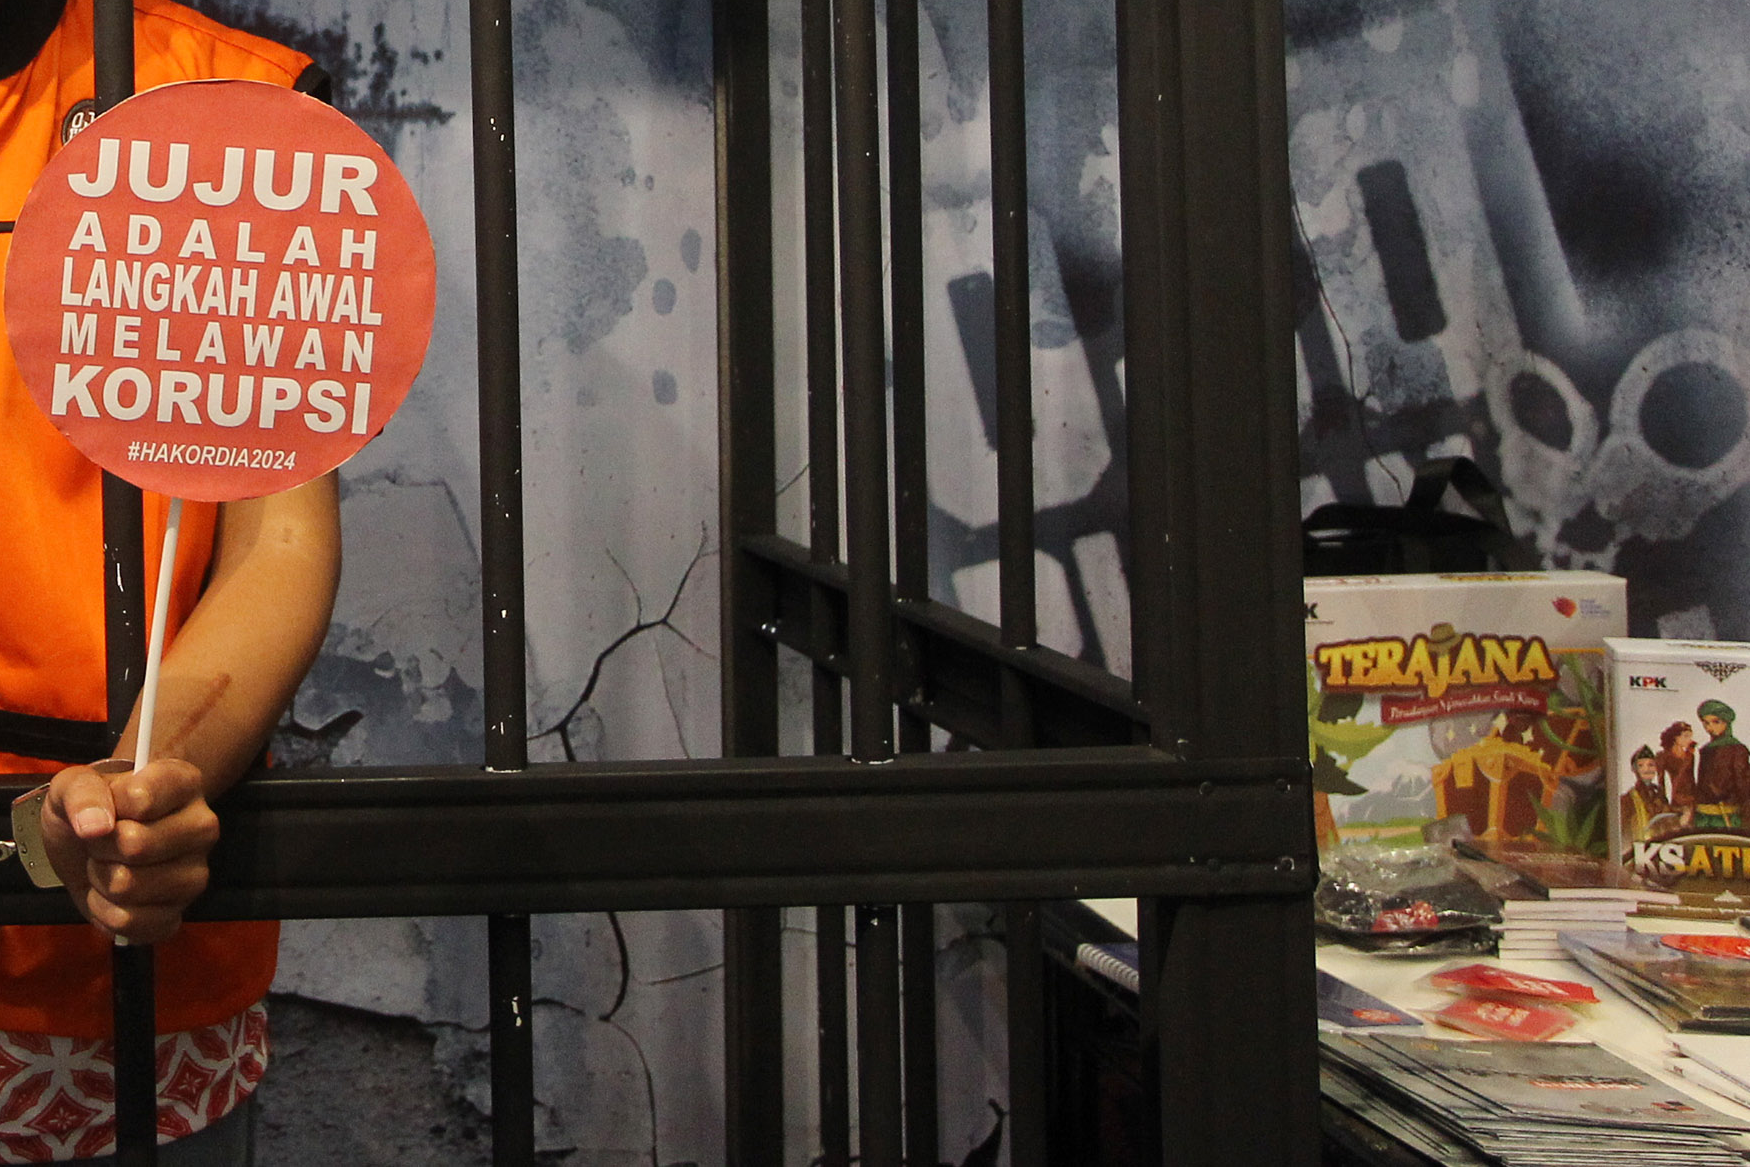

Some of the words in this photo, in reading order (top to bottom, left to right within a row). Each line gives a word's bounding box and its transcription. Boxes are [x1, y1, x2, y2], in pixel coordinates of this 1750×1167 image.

[67, 137, 379, 216] JUJUR
[68, 210, 377, 270] ADALAH
[60, 256, 259, 318] LANGKAH
[268, 271, 383, 326] AWAL
[60, 311, 374, 374] MELAWAN
[51, 363, 371, 435] KORUPSI
[127, 440, 296, 471] #HAKORDIA2024
[1317, 634, 1556, 698] TERAJANA
[1629, 675, 1667, 688] KPK
